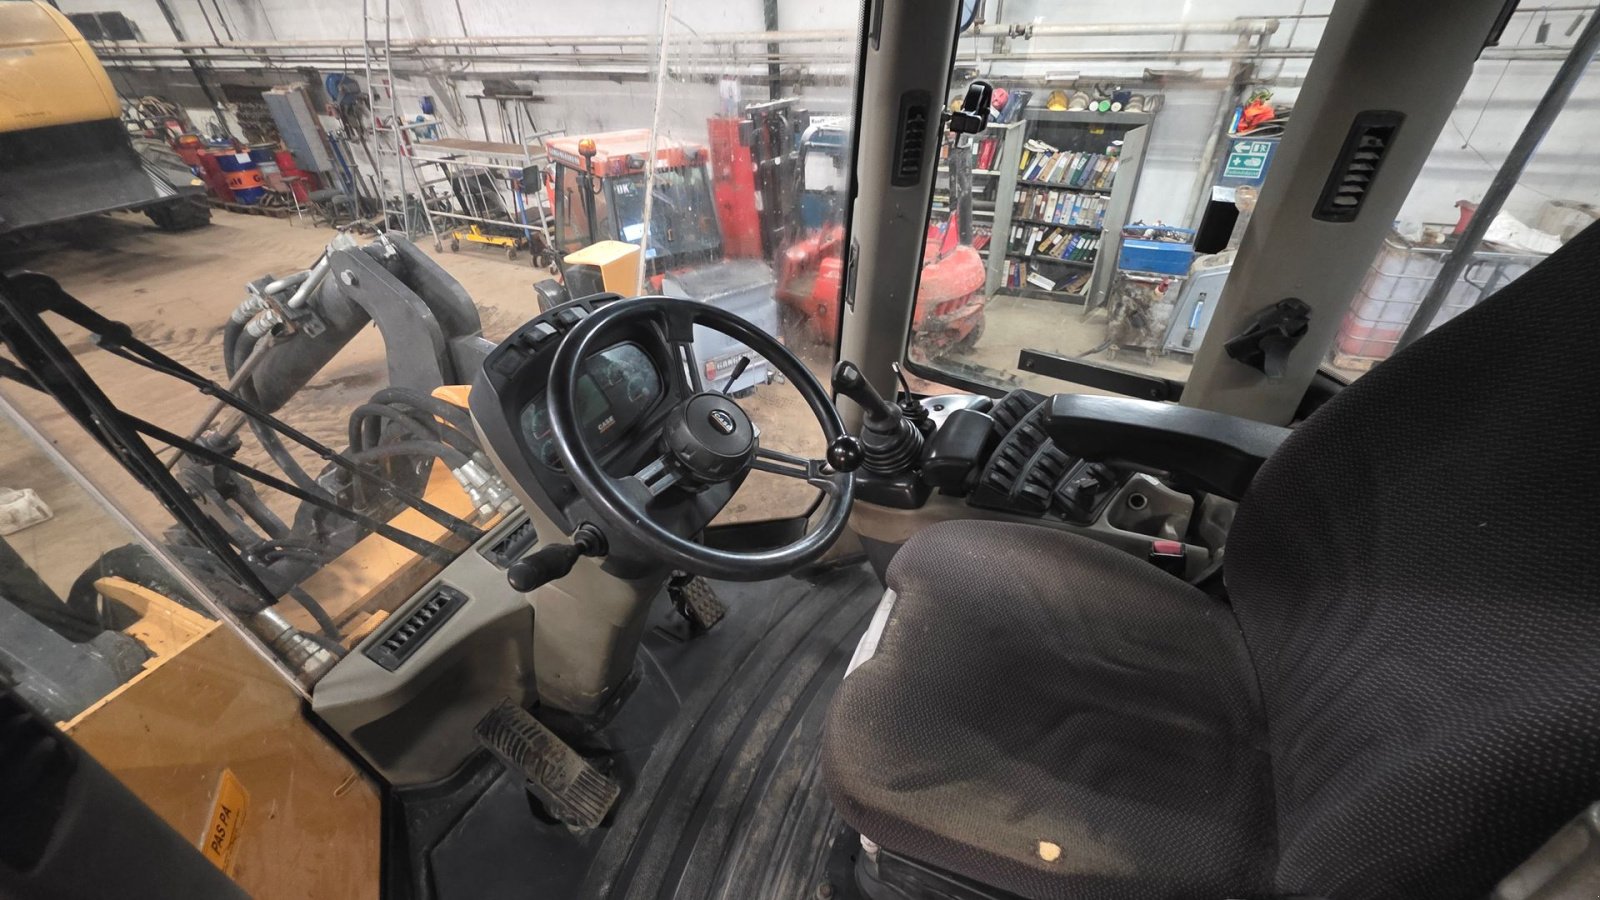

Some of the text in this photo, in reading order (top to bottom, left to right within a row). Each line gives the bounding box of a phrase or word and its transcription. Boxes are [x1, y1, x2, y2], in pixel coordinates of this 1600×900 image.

[598, 415, 615, 431] CASE
[714, 413, 732, 431] CASE
[211, 824, 226, 856] PAS
